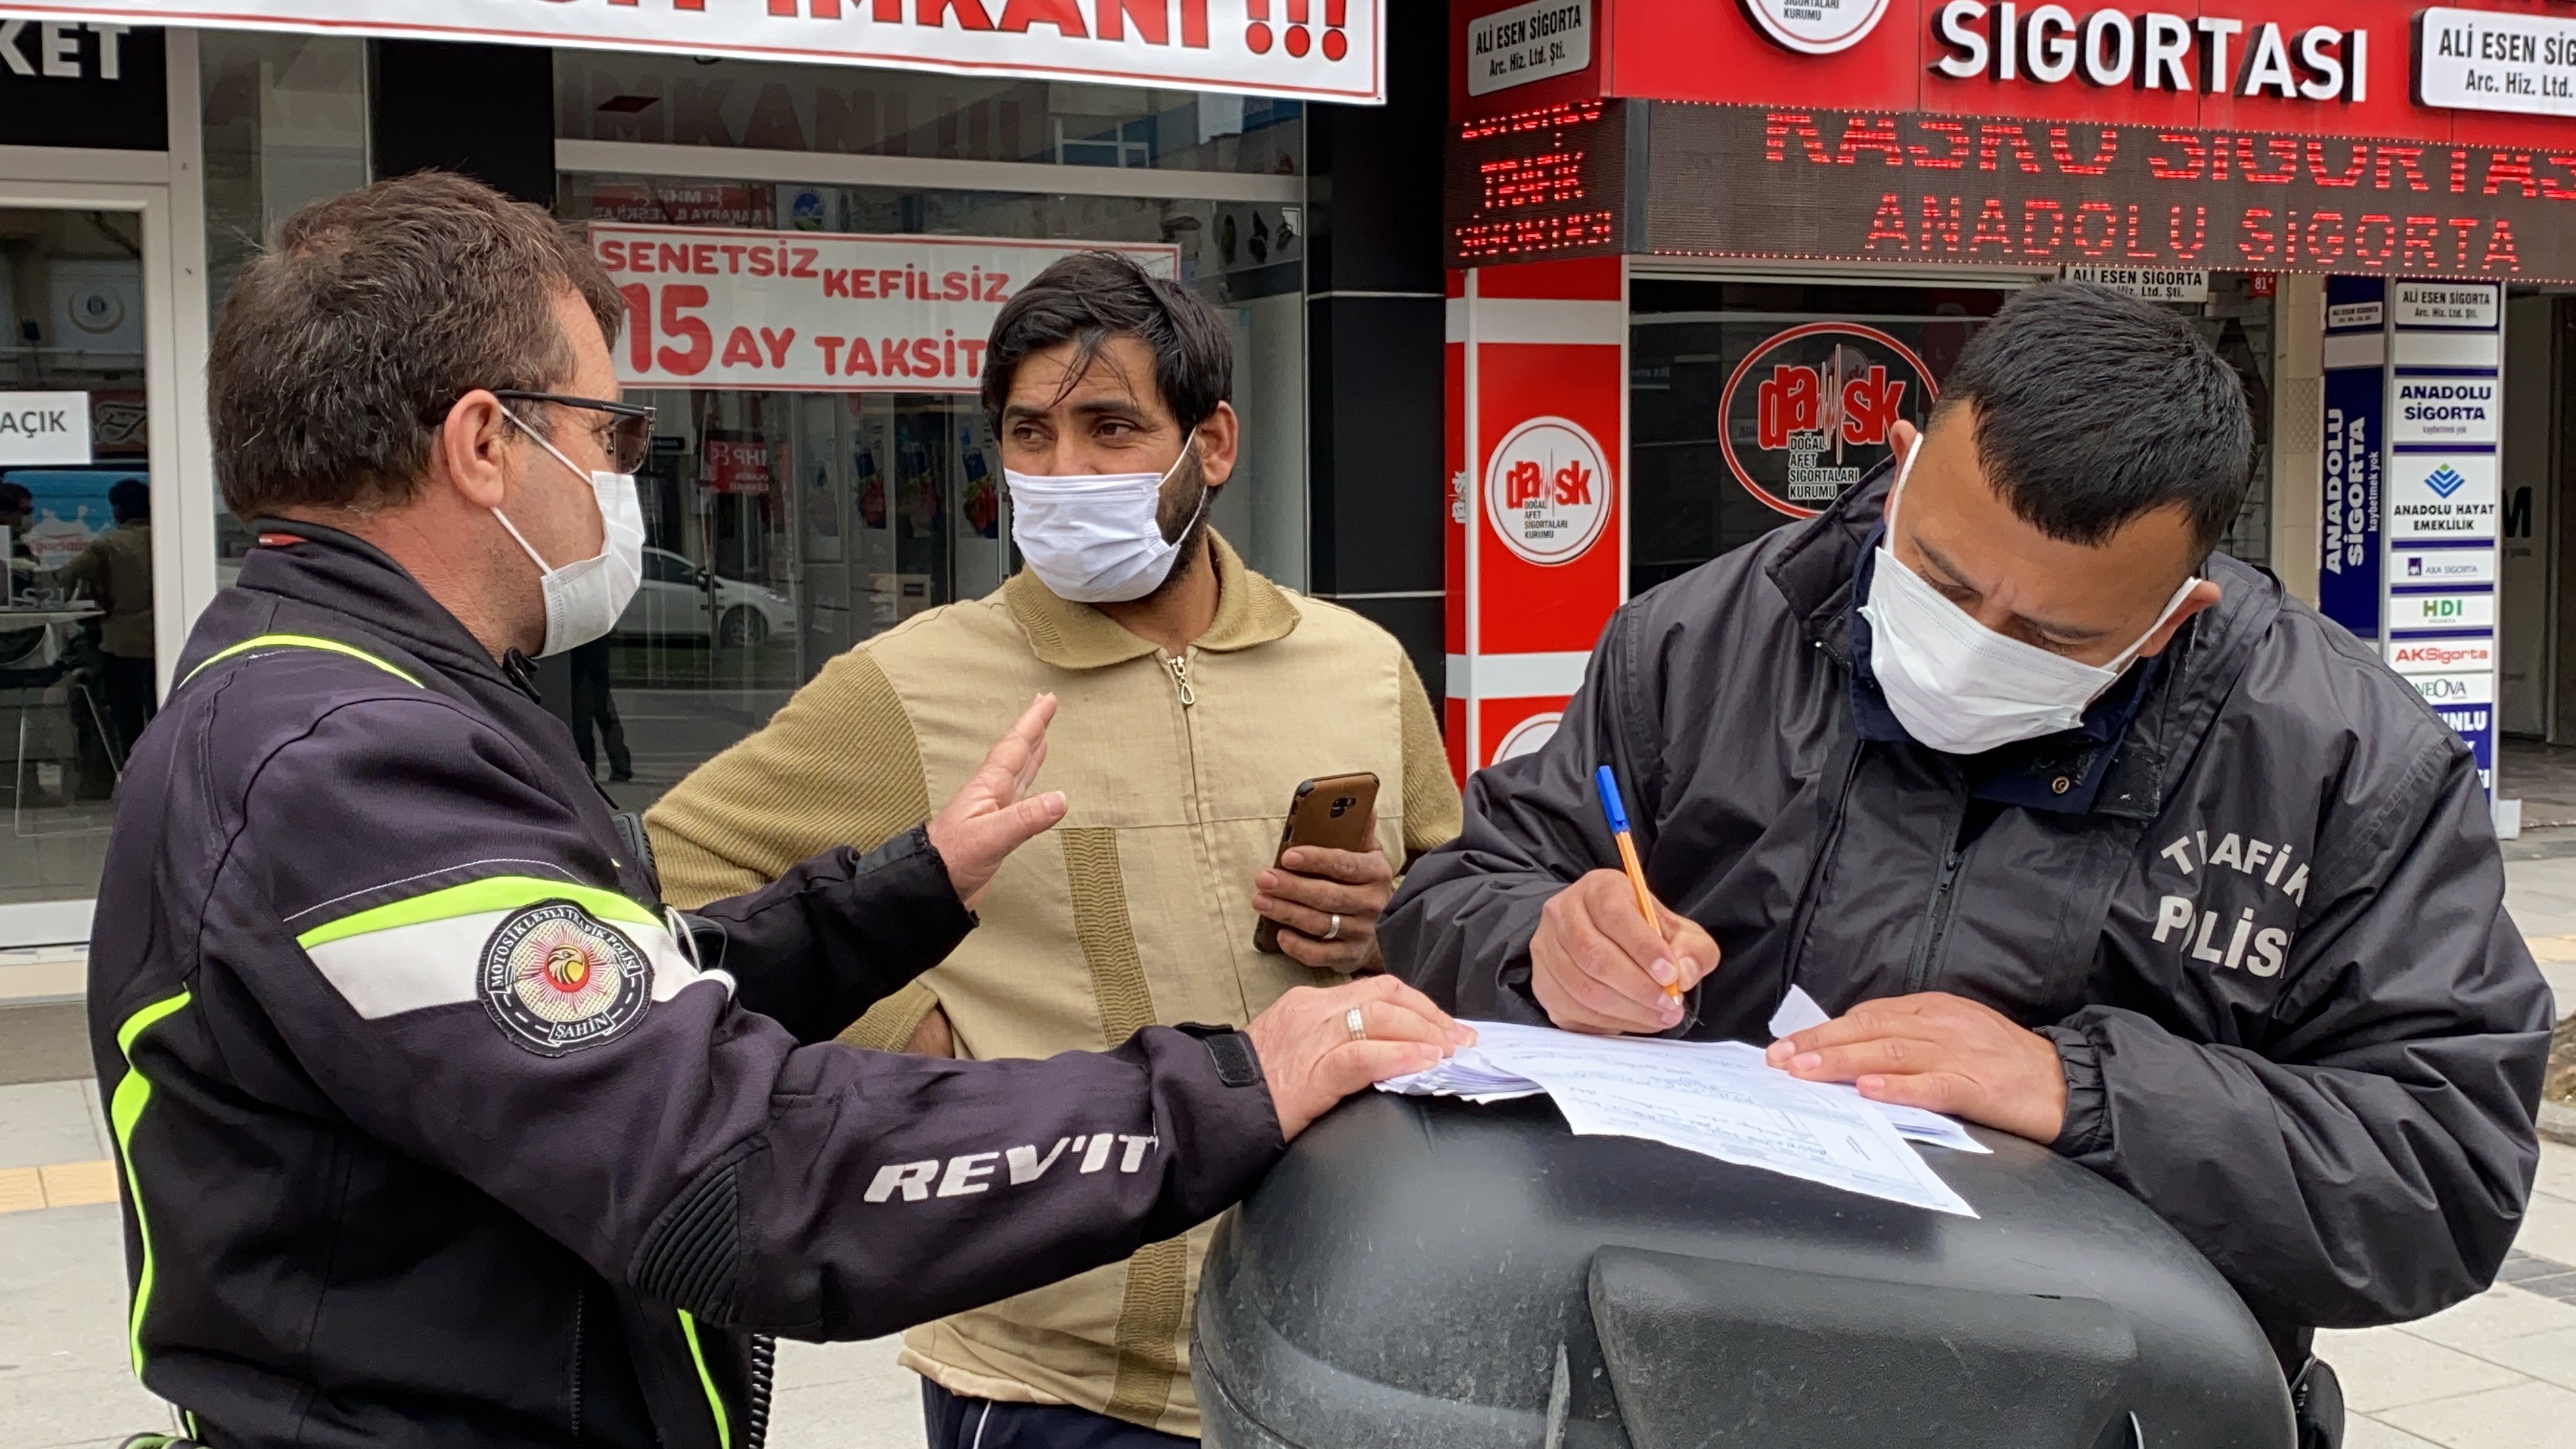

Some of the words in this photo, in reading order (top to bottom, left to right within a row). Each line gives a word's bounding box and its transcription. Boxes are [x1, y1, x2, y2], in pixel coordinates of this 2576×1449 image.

[1783, 8, 1821, 20] KURUMU
[1476, 24, 1493, 56] ALİ
[1497, 20, 1526, 49] ESEN
[1530, 5, 1581, 40] SİGORTA
[1936, 0, 2368, 102] SIGORTASI
[2438, 23, 2474, 58] ALİ
[2481, 31, 2536, 63] ESEN
[2465, 70, 2499, 92] Arc.
[2506, 72, 2536, 95] Hiz.
[2542, 75, 2573, 98] Ltd.
[1865, 192, 2207, 261] ANADOLU
[599, 239, 819, 279] SENETSİZ
[823, 263, 1011, 302] KEFİLSİZ
[2100, 269, 2137, 285] ESEN
[2421, 291, 2446, 304] ESEN
[2449, 290, 2490, 305] SİGORTA
[618, 282, 713, 377] 15
[721, 326, 795, 370] AY
[2400, 386, 2492, 400] ANADOLU
[2403, 401, 2486, 420] SİGORTA
[0, 411, 67, 438] AÇIK
[1790, 433, 1825, 451] DOĞAL
[1789, 454, 1816, 468] AFET
[1789, 468, 1860, 483] SİGORTALARI
[1789, 485, 1838, 499] KURUMU
[2326, 408, 2343, 574] ANADOLU
[2343, 416, 2365, 566] SİGORTA
[2367, 471, 2380, 532] kaybetmek
[2394, 504, 2452, 515] ANADOLU
[2456, 503, 2494, 514] HAYAT
[2414, 517, 2474, 531] EMEKLİLİK
[2423, 599, 2462, 617] HDI
[2395, 648, 2488, 664] AKSigorta
[2152, 895, 2294, 979] PLİS
[555, 1014, 609, 1039] ŞAHİN
